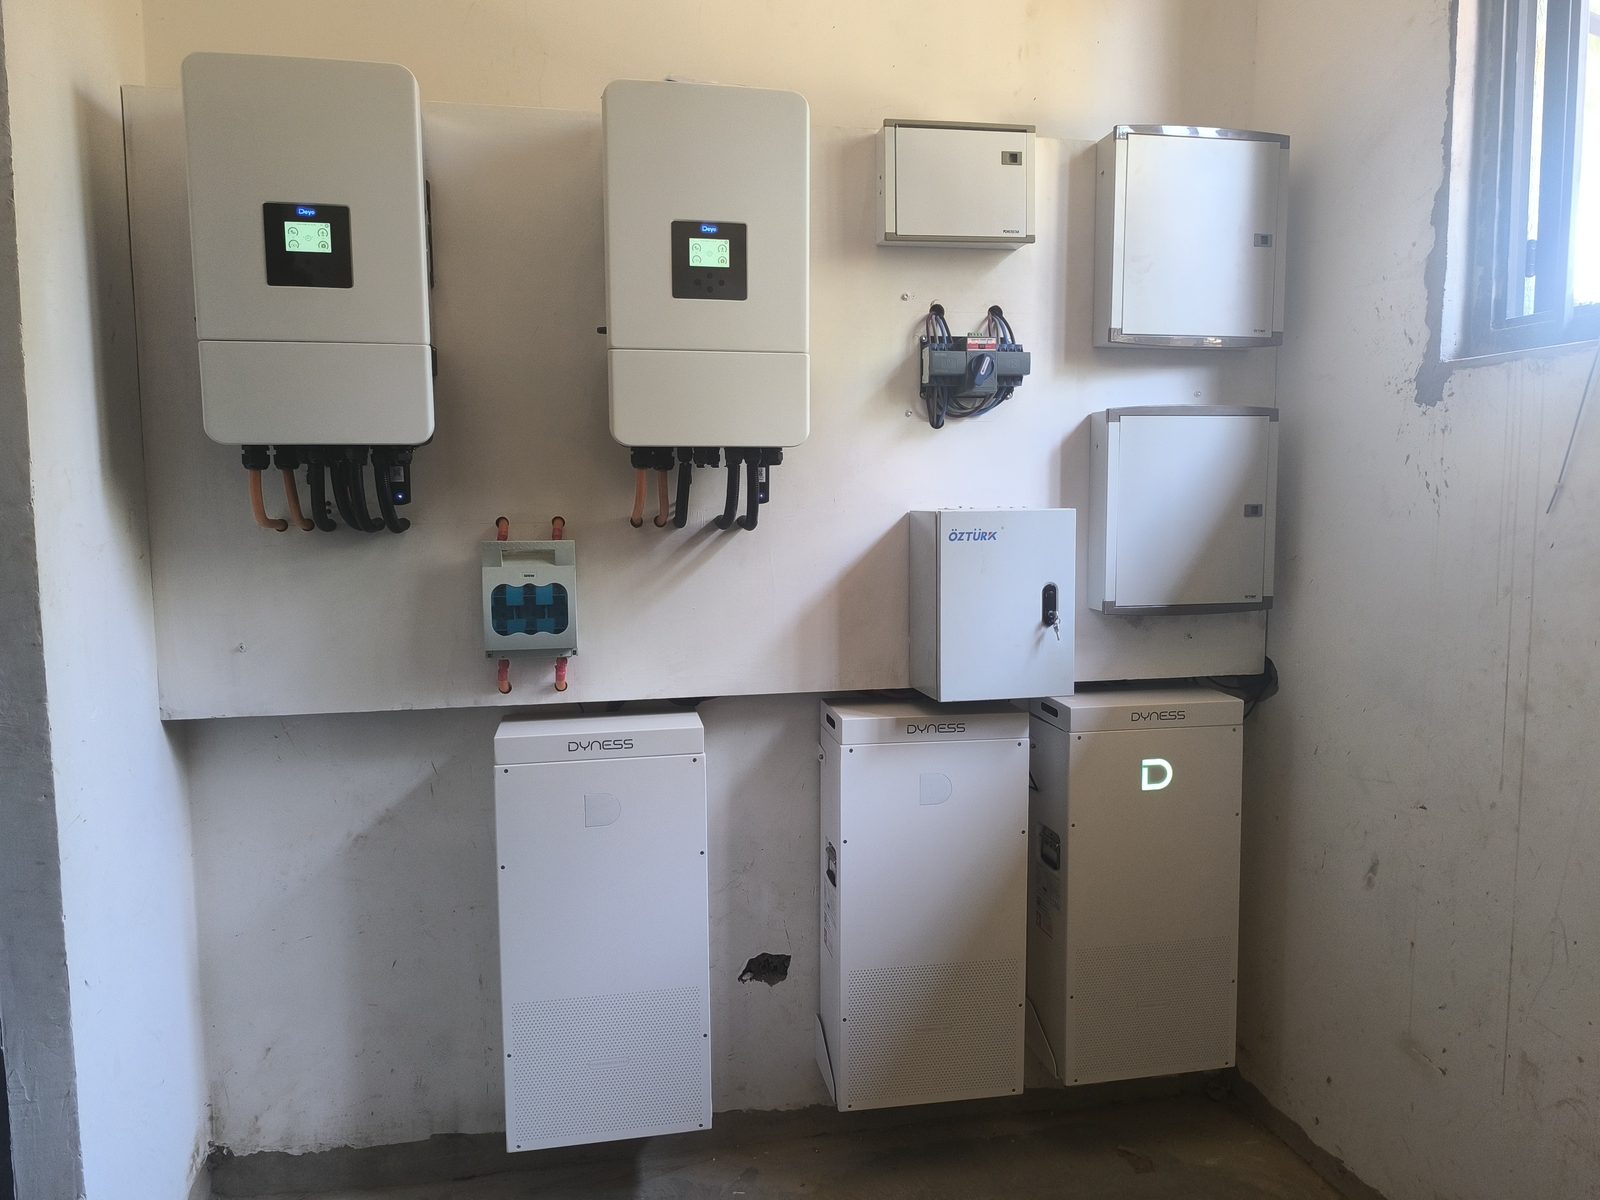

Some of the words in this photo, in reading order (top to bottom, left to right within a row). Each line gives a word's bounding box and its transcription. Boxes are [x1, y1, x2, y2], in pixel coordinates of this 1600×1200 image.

[948, 528, 998, 542] ÖZTÜRK
[1130, 710, 1186, 722] DYNESS
[906, 722, 966, 735] DYNESS
[567, 738, 634, 752] DYNESS
